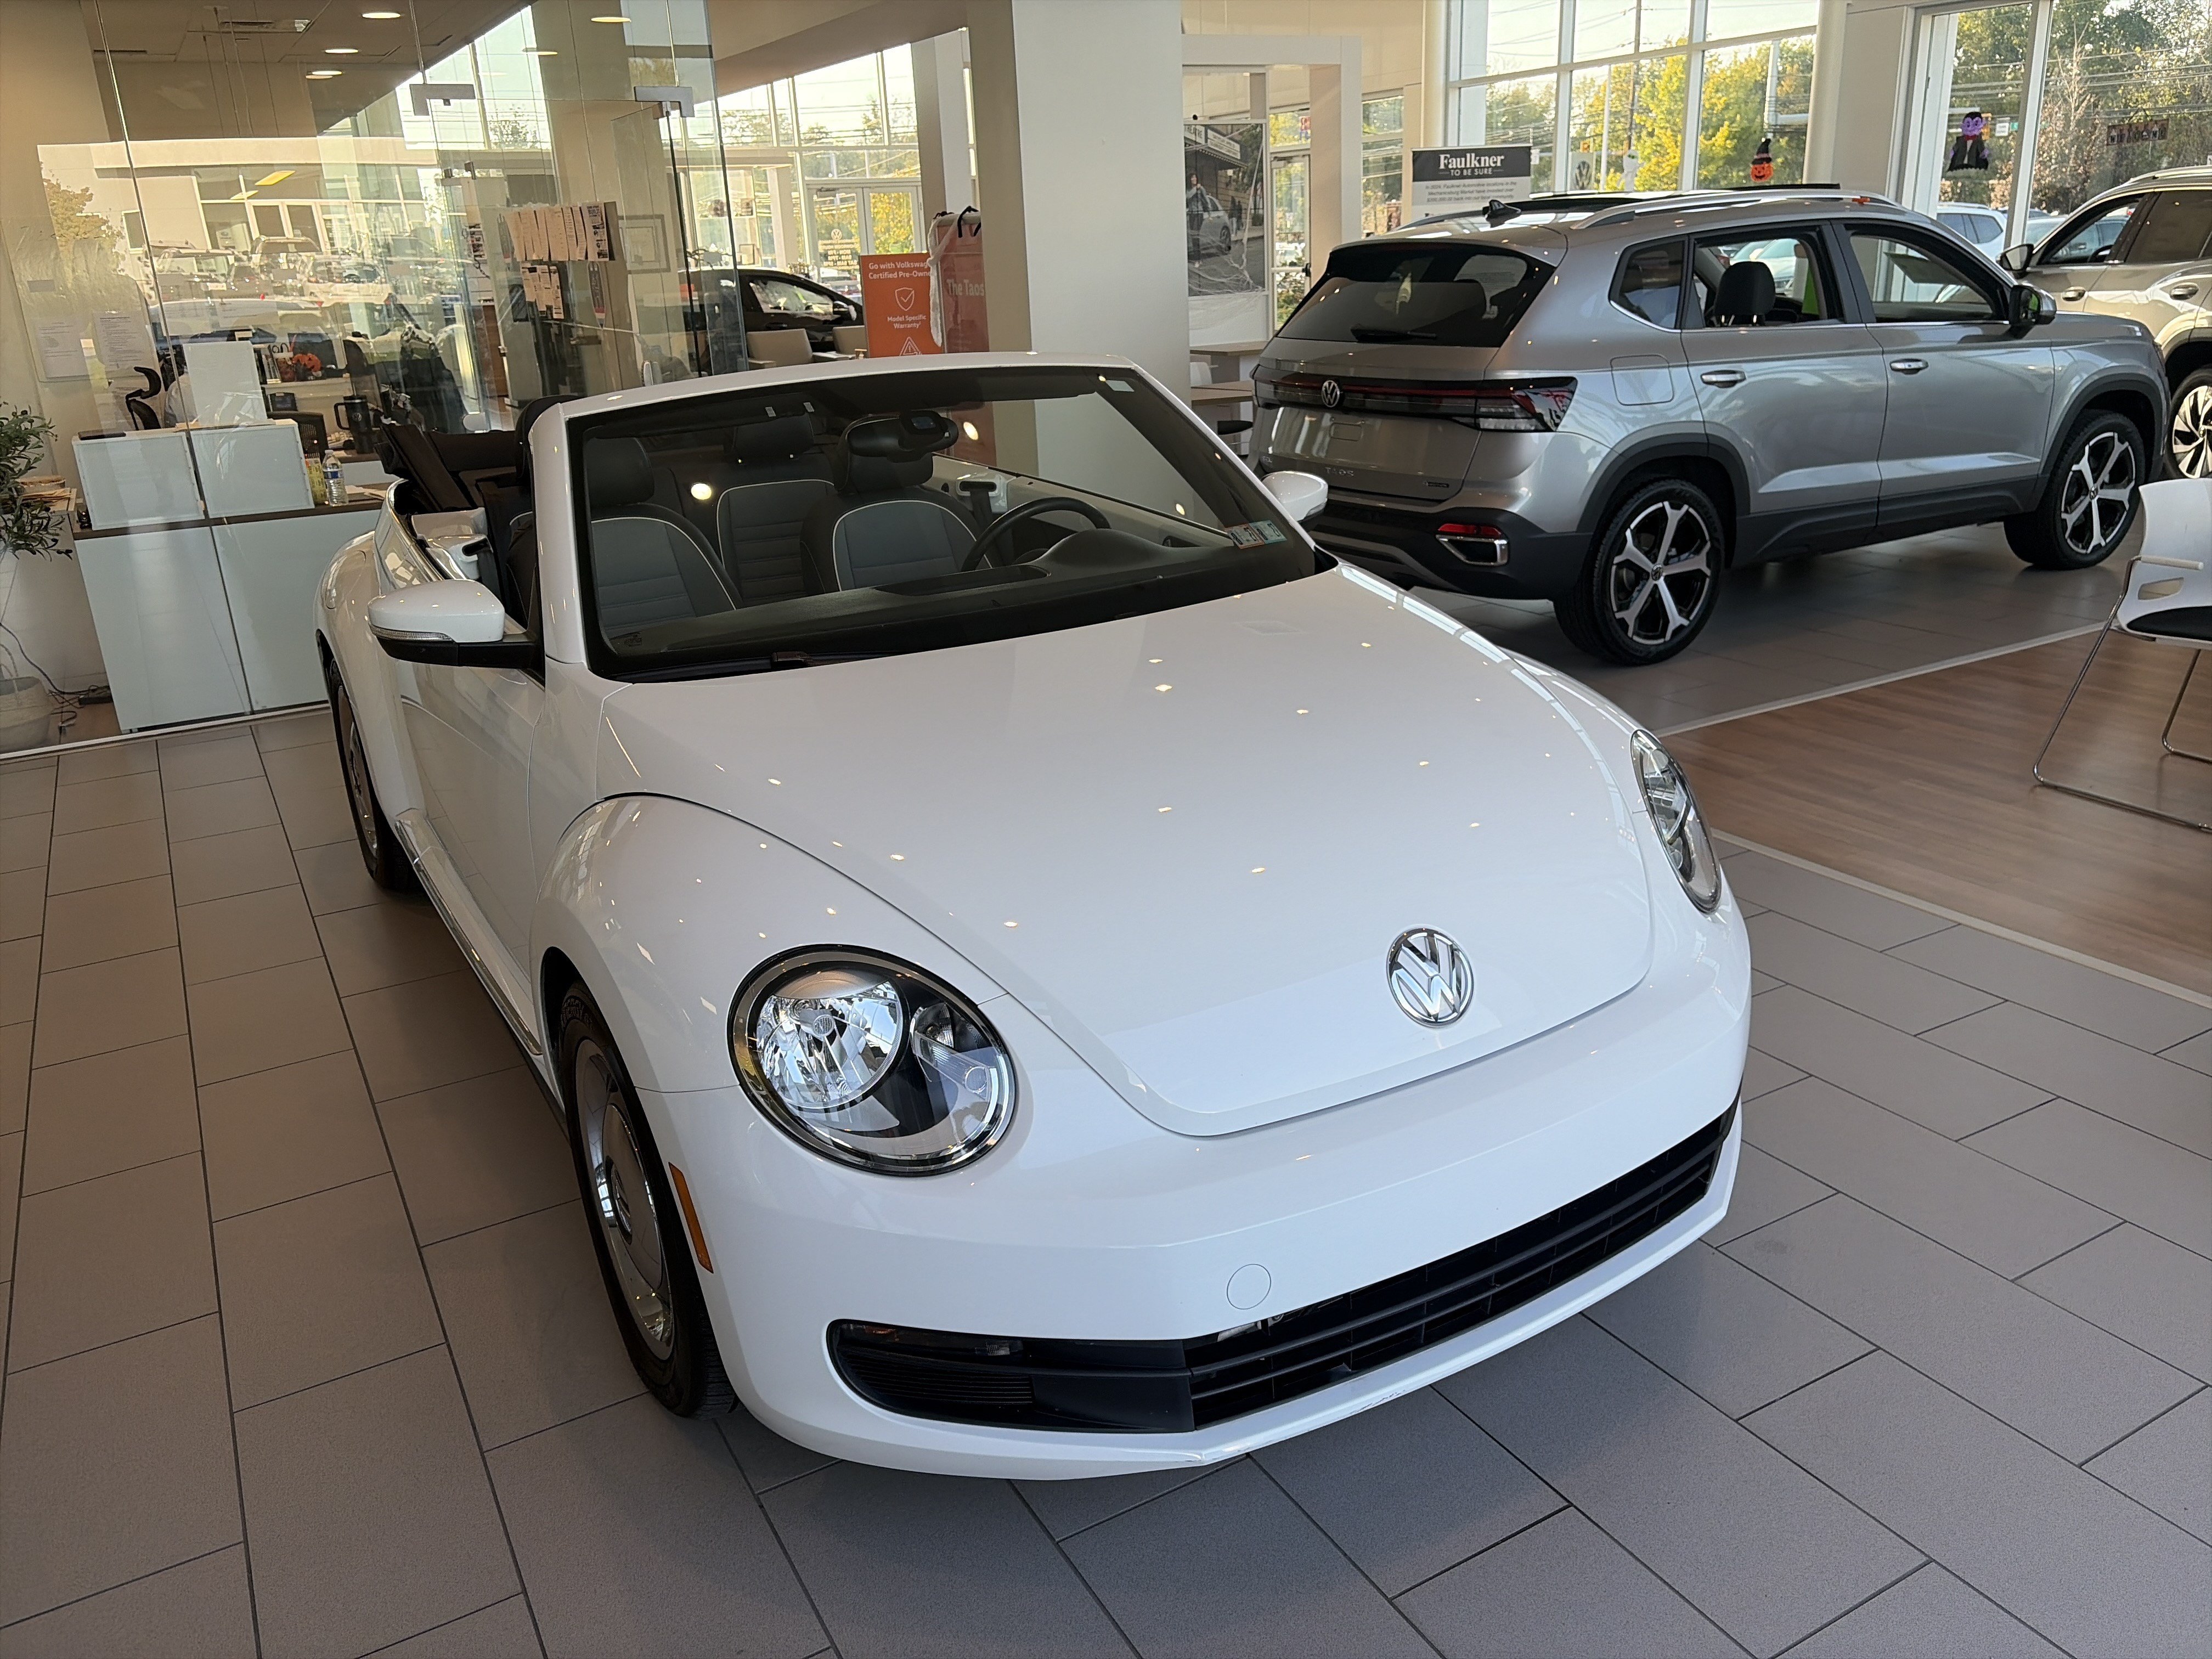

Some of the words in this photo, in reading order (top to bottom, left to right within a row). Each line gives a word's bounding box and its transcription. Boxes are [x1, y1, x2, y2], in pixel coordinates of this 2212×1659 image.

[1438, 153, 1505, 170] Faulkner
[946, 279, 962, 296] The
[1386, 928, 1474, 1028] VW
